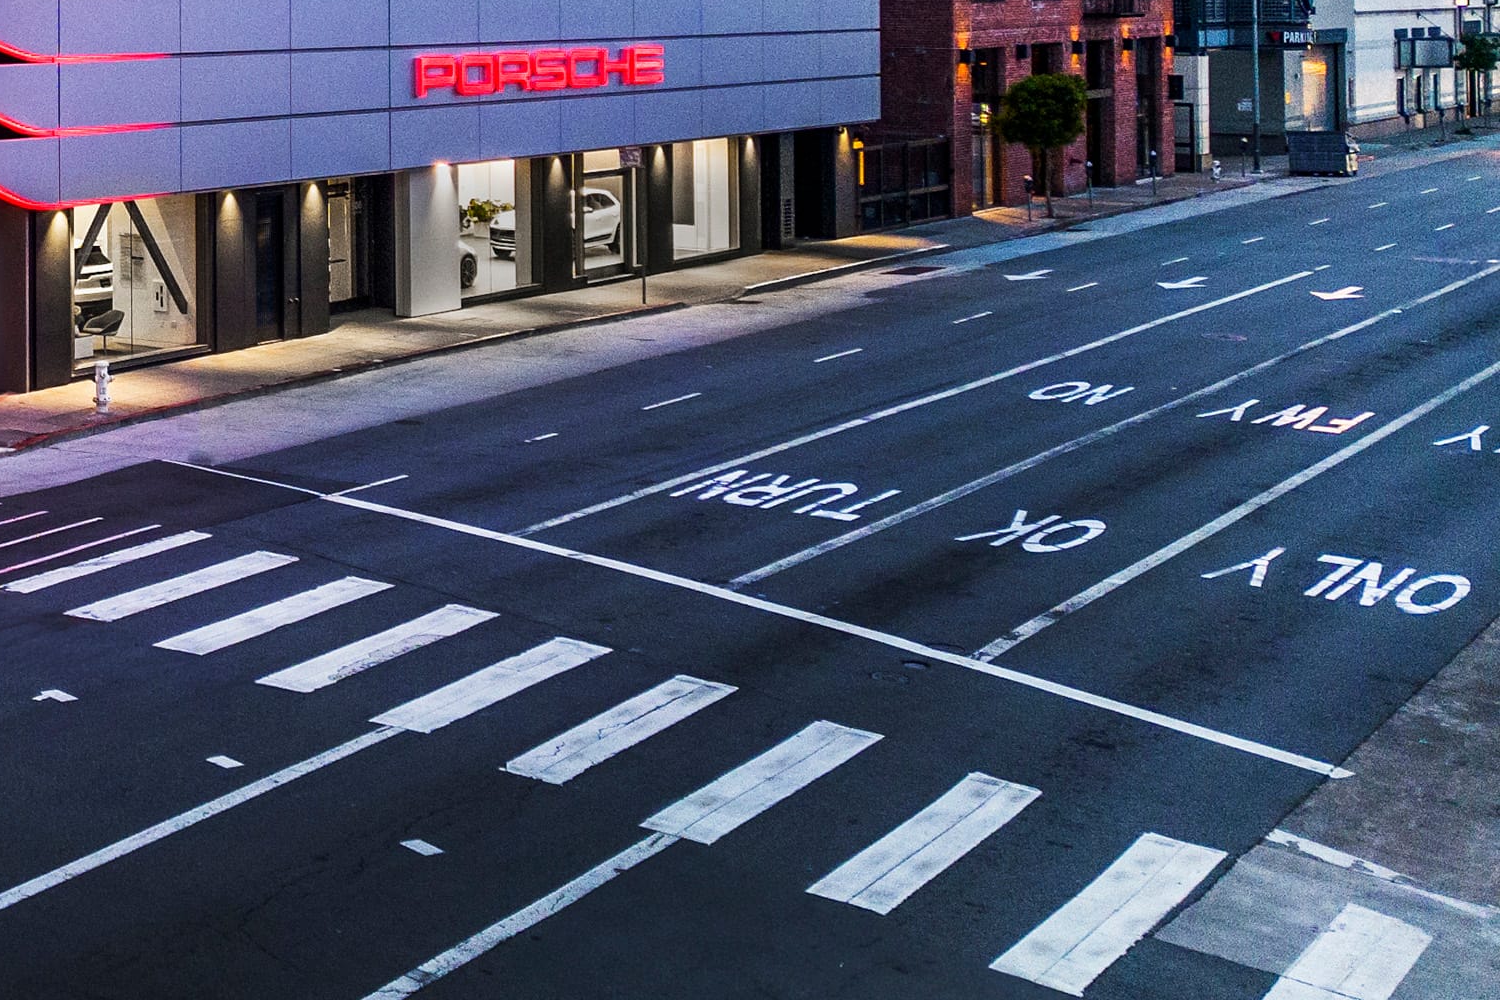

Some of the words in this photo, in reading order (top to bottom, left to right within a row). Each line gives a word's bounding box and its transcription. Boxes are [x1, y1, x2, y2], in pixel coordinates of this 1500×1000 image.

[414, 43, 665, 98] PORSCHE
[1028, 381, 1135, 405] NO
[1195, 398, 1376, 434] FWY
[669, 469, 902, 521] TURN
[954, 508, 1107, 553] OK
[1200, 546, 1471, 615] ONLY
